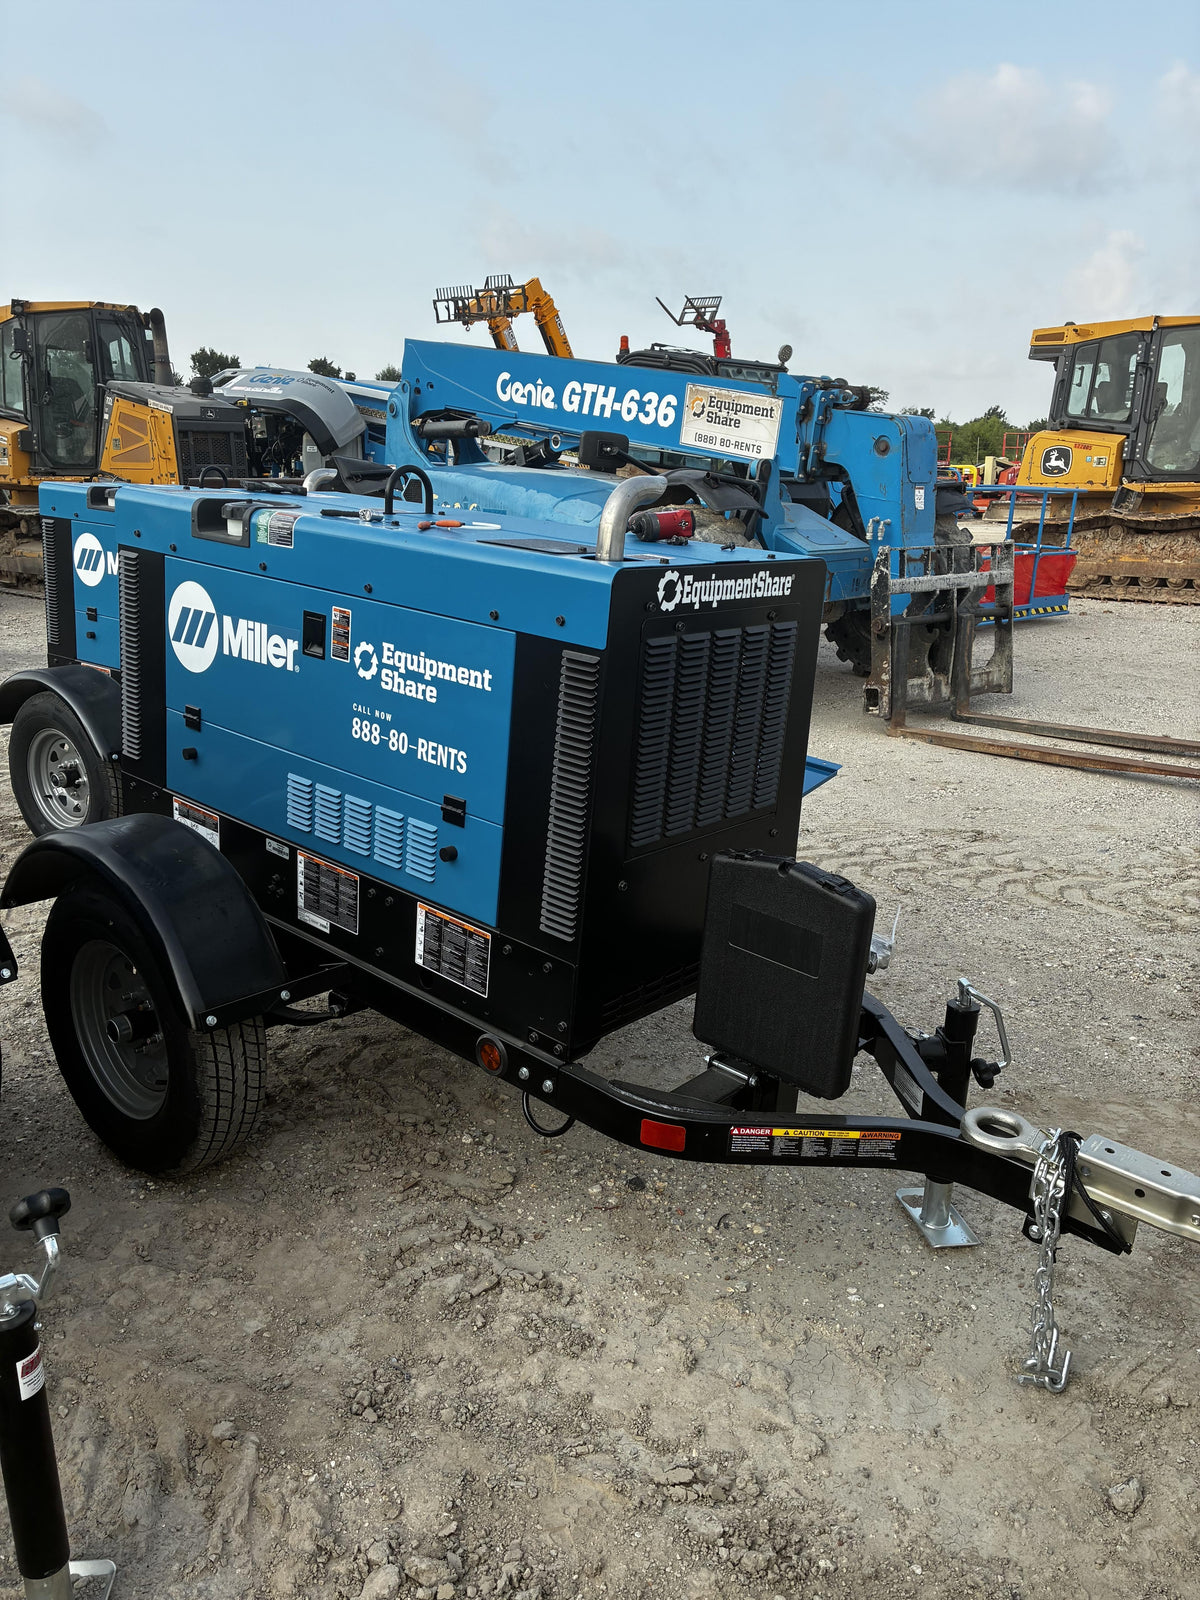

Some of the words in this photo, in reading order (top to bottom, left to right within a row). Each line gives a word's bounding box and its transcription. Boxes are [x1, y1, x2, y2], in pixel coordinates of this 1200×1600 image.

[249, 373, 296, 385] Genie
[496, 371, 556, 409] Genie
[562, 380, 678, 428] GTH-636
[708, 395, 775, 419] Equipment
[706, 411, 741, 429] Share
[694, 432, 717, 446] (888)
[719, 437, 763, 455] 80-RENTS
[682, 570, 793, 610] EquipmentShare
[222, 614, 299, 672] Miller
[381, 642, 493, 692] Equipment
[380, 668, 438, 704] Share
[352, 702, 372, 716] CALL
[375, 709, 393, 722] NOW
[351, 717, 468, 774] 888-80-RENTS
